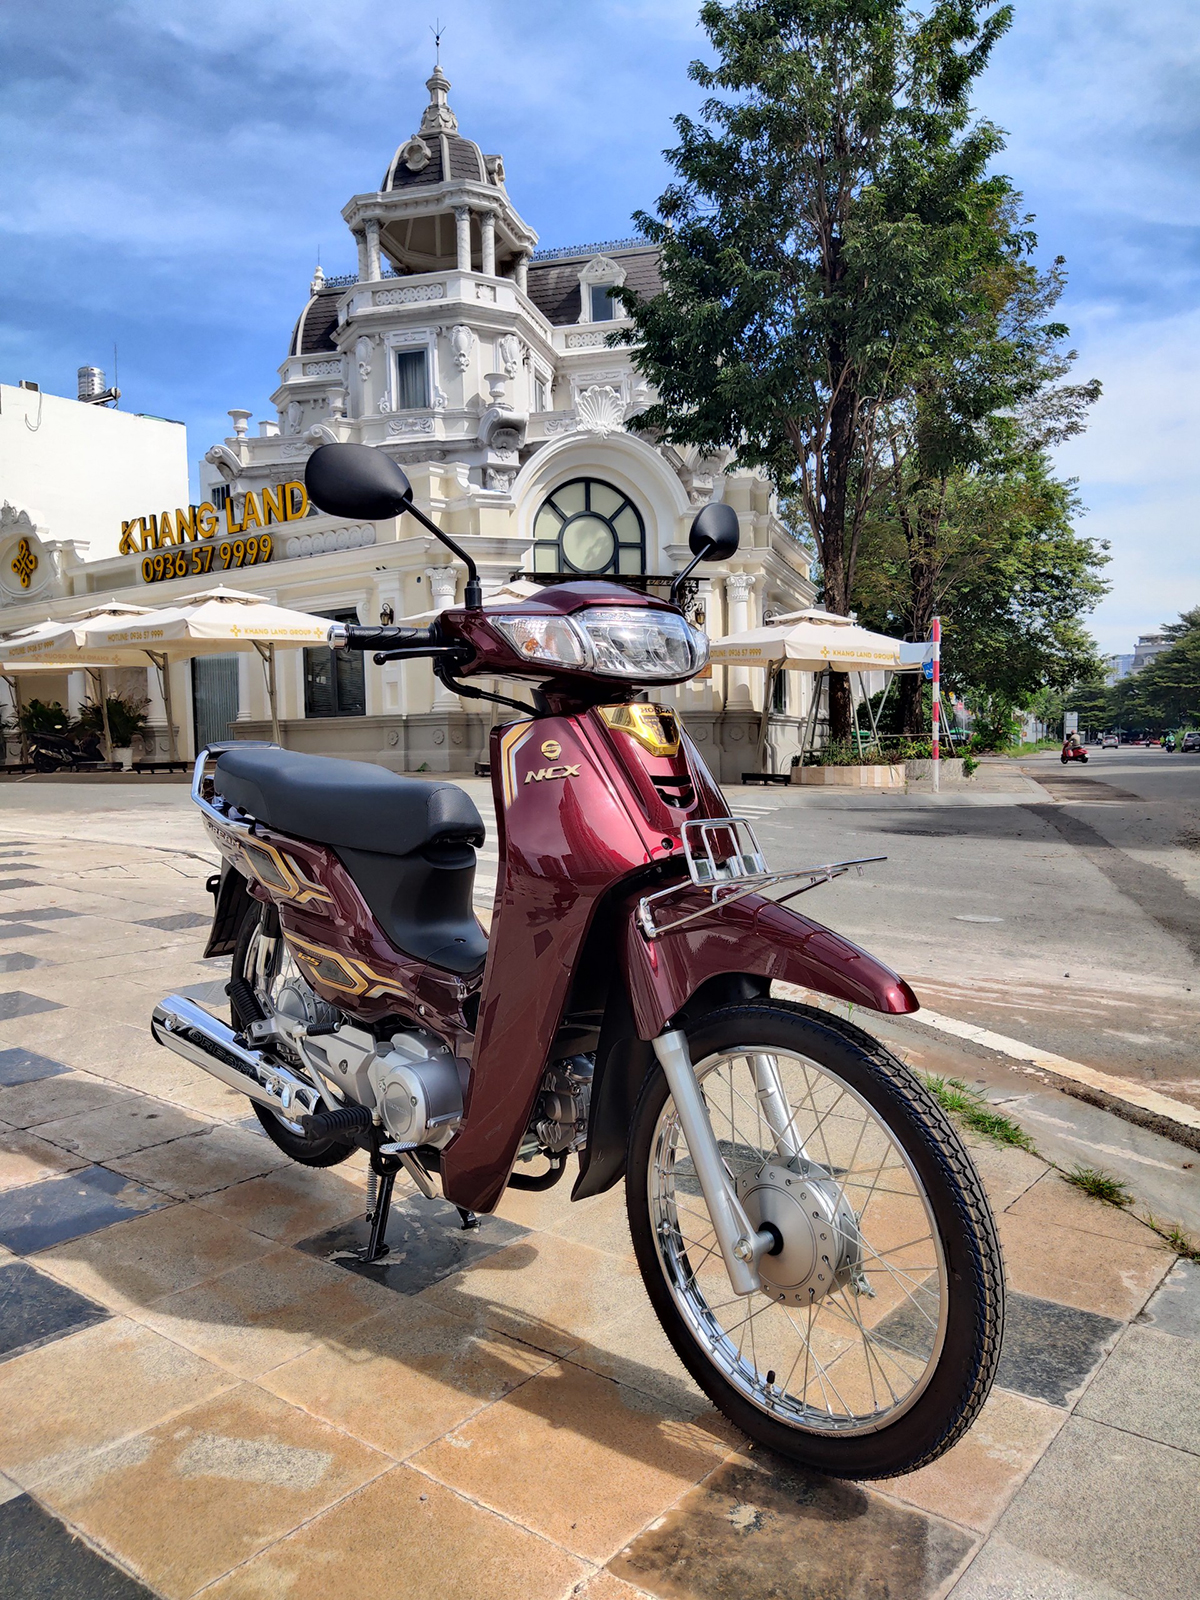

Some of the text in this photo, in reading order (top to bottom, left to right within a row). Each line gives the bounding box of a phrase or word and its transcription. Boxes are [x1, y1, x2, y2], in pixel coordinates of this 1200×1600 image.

[119, 481, 309, 554] KHANG LAND
[141, 534, 274, 583] 0936 57 9999
[130, 631, 142, 640] 0936
[144, 630, 150, 639] 57
[151, 629, 164, 638] 9999
[270, 628, 288, 636] LAND
[728, 648, 740, 656] 0936
[741, 648, 748, 656] 57
[749, 648, 762, 656] 9999
[832, 649, 894, 661] KHANG LAND GROUP
[188, 1029, 254, 1077] DREAM
